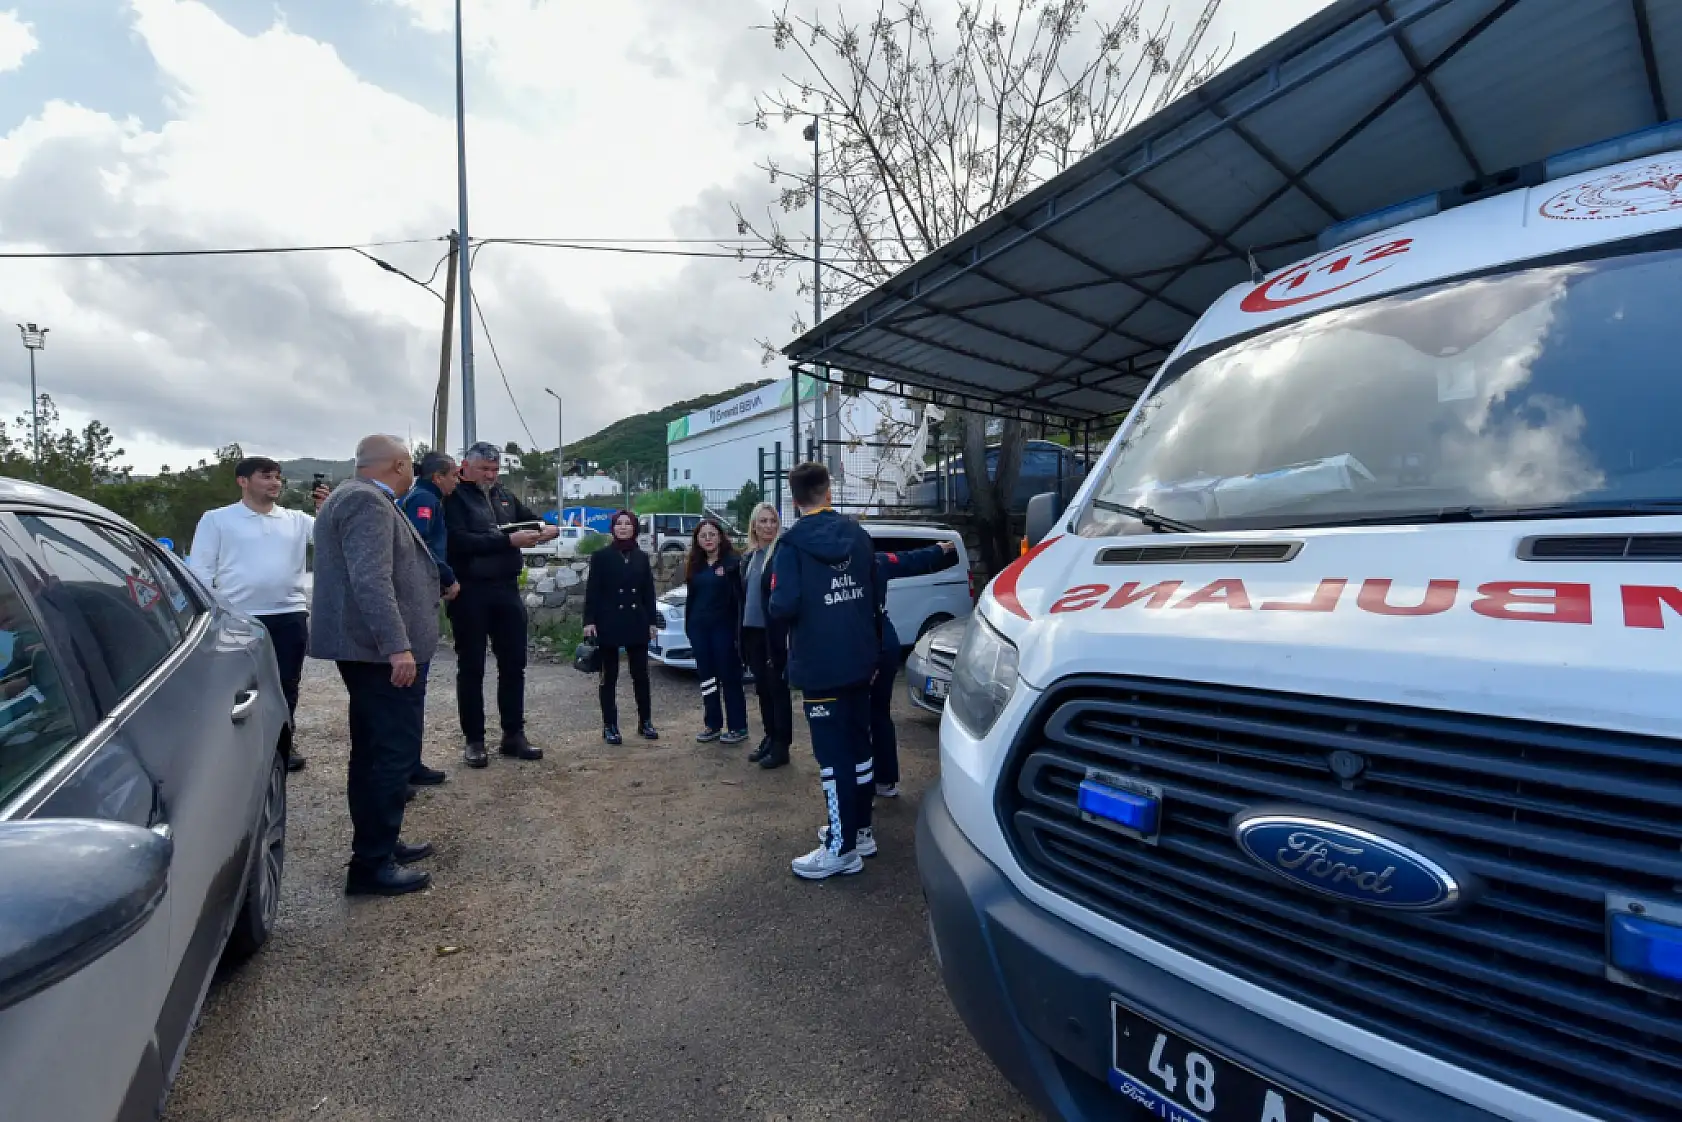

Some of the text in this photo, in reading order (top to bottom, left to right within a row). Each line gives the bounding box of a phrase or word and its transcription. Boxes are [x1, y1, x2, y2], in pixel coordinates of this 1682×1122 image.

[1278, 238, 1414, 292] 112
[1277, 832, 1396, 894] Ford
[1148, 1033, 1331, 1122] 48 A
